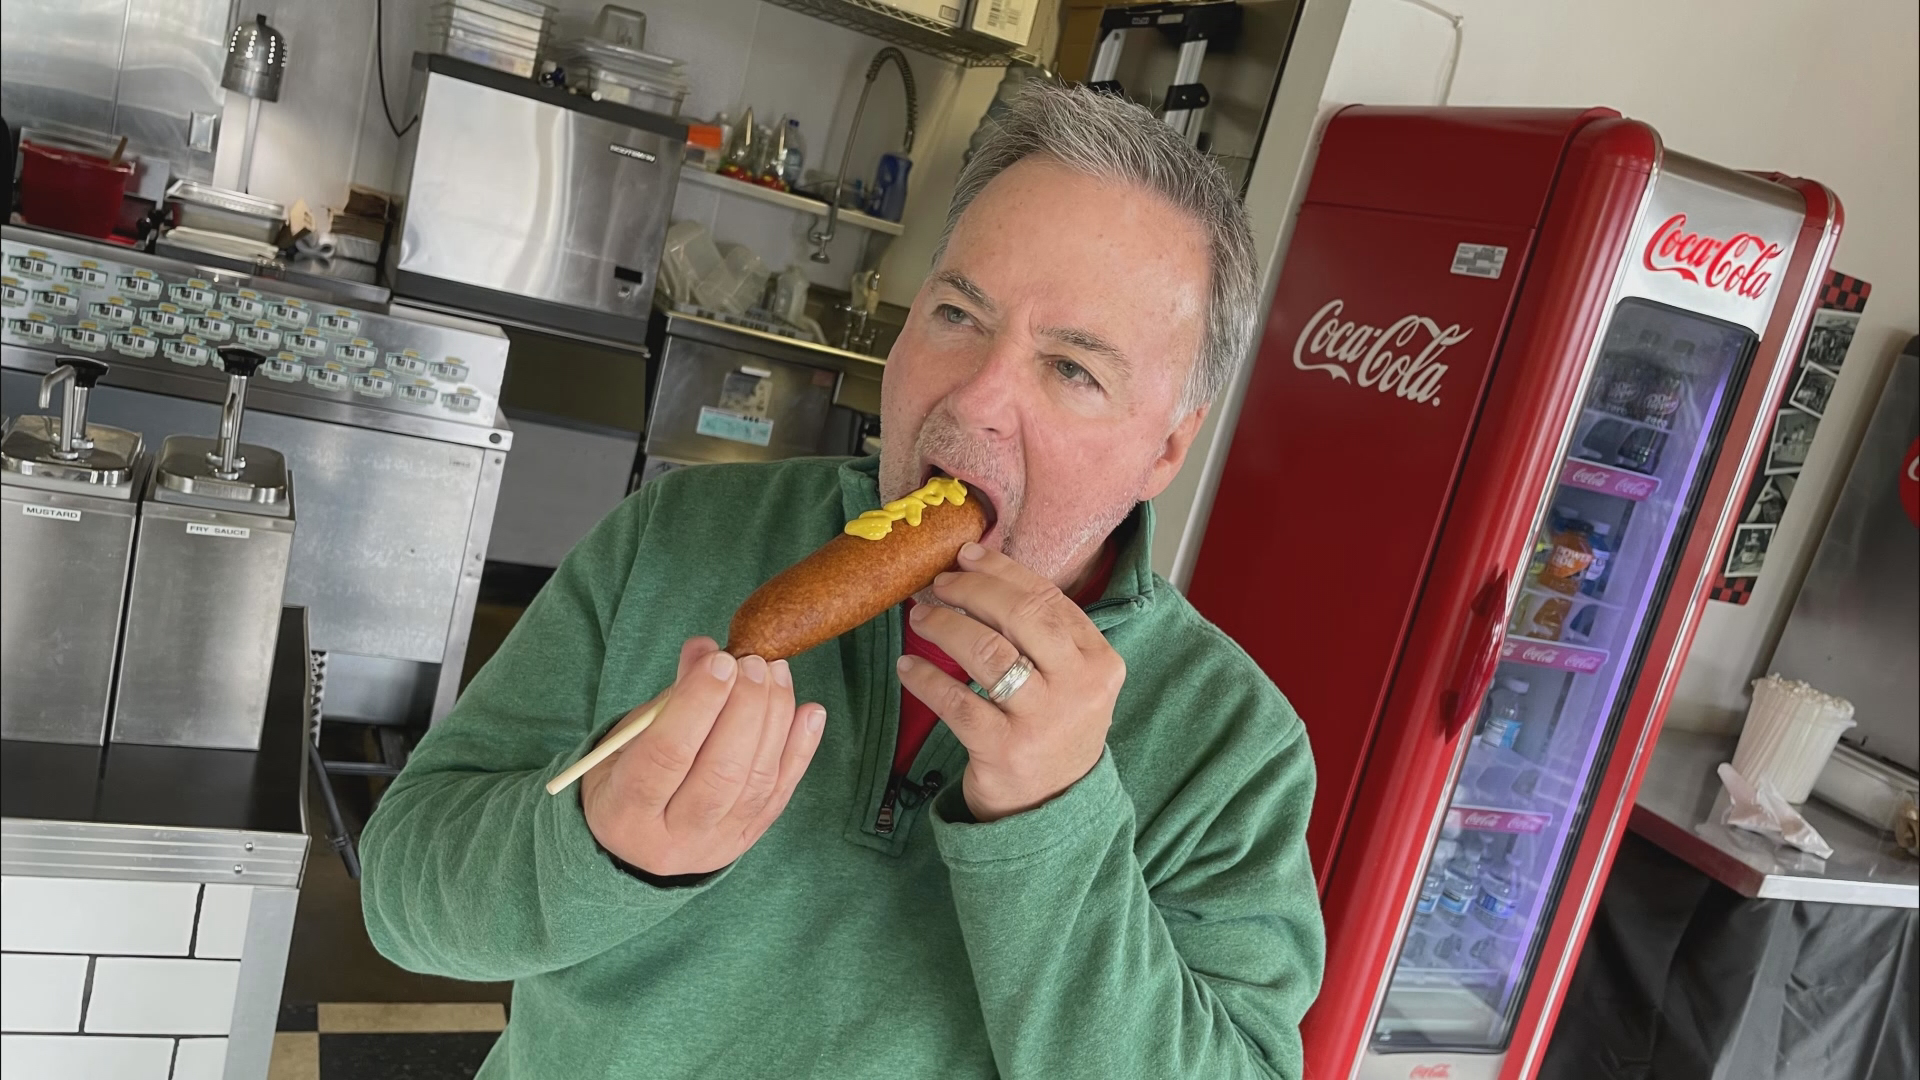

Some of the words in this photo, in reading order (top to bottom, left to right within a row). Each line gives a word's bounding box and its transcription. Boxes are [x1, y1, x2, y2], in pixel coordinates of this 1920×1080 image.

[1643, 213, 1784, 300] Coca-Cola
[1293, 298, 1473, 407] Coca-Cola
[26, 506, 78, 518] MUSTARD
[189, 525, 209, 533] FRY
[214, 527, 247, 537] SAUCE
